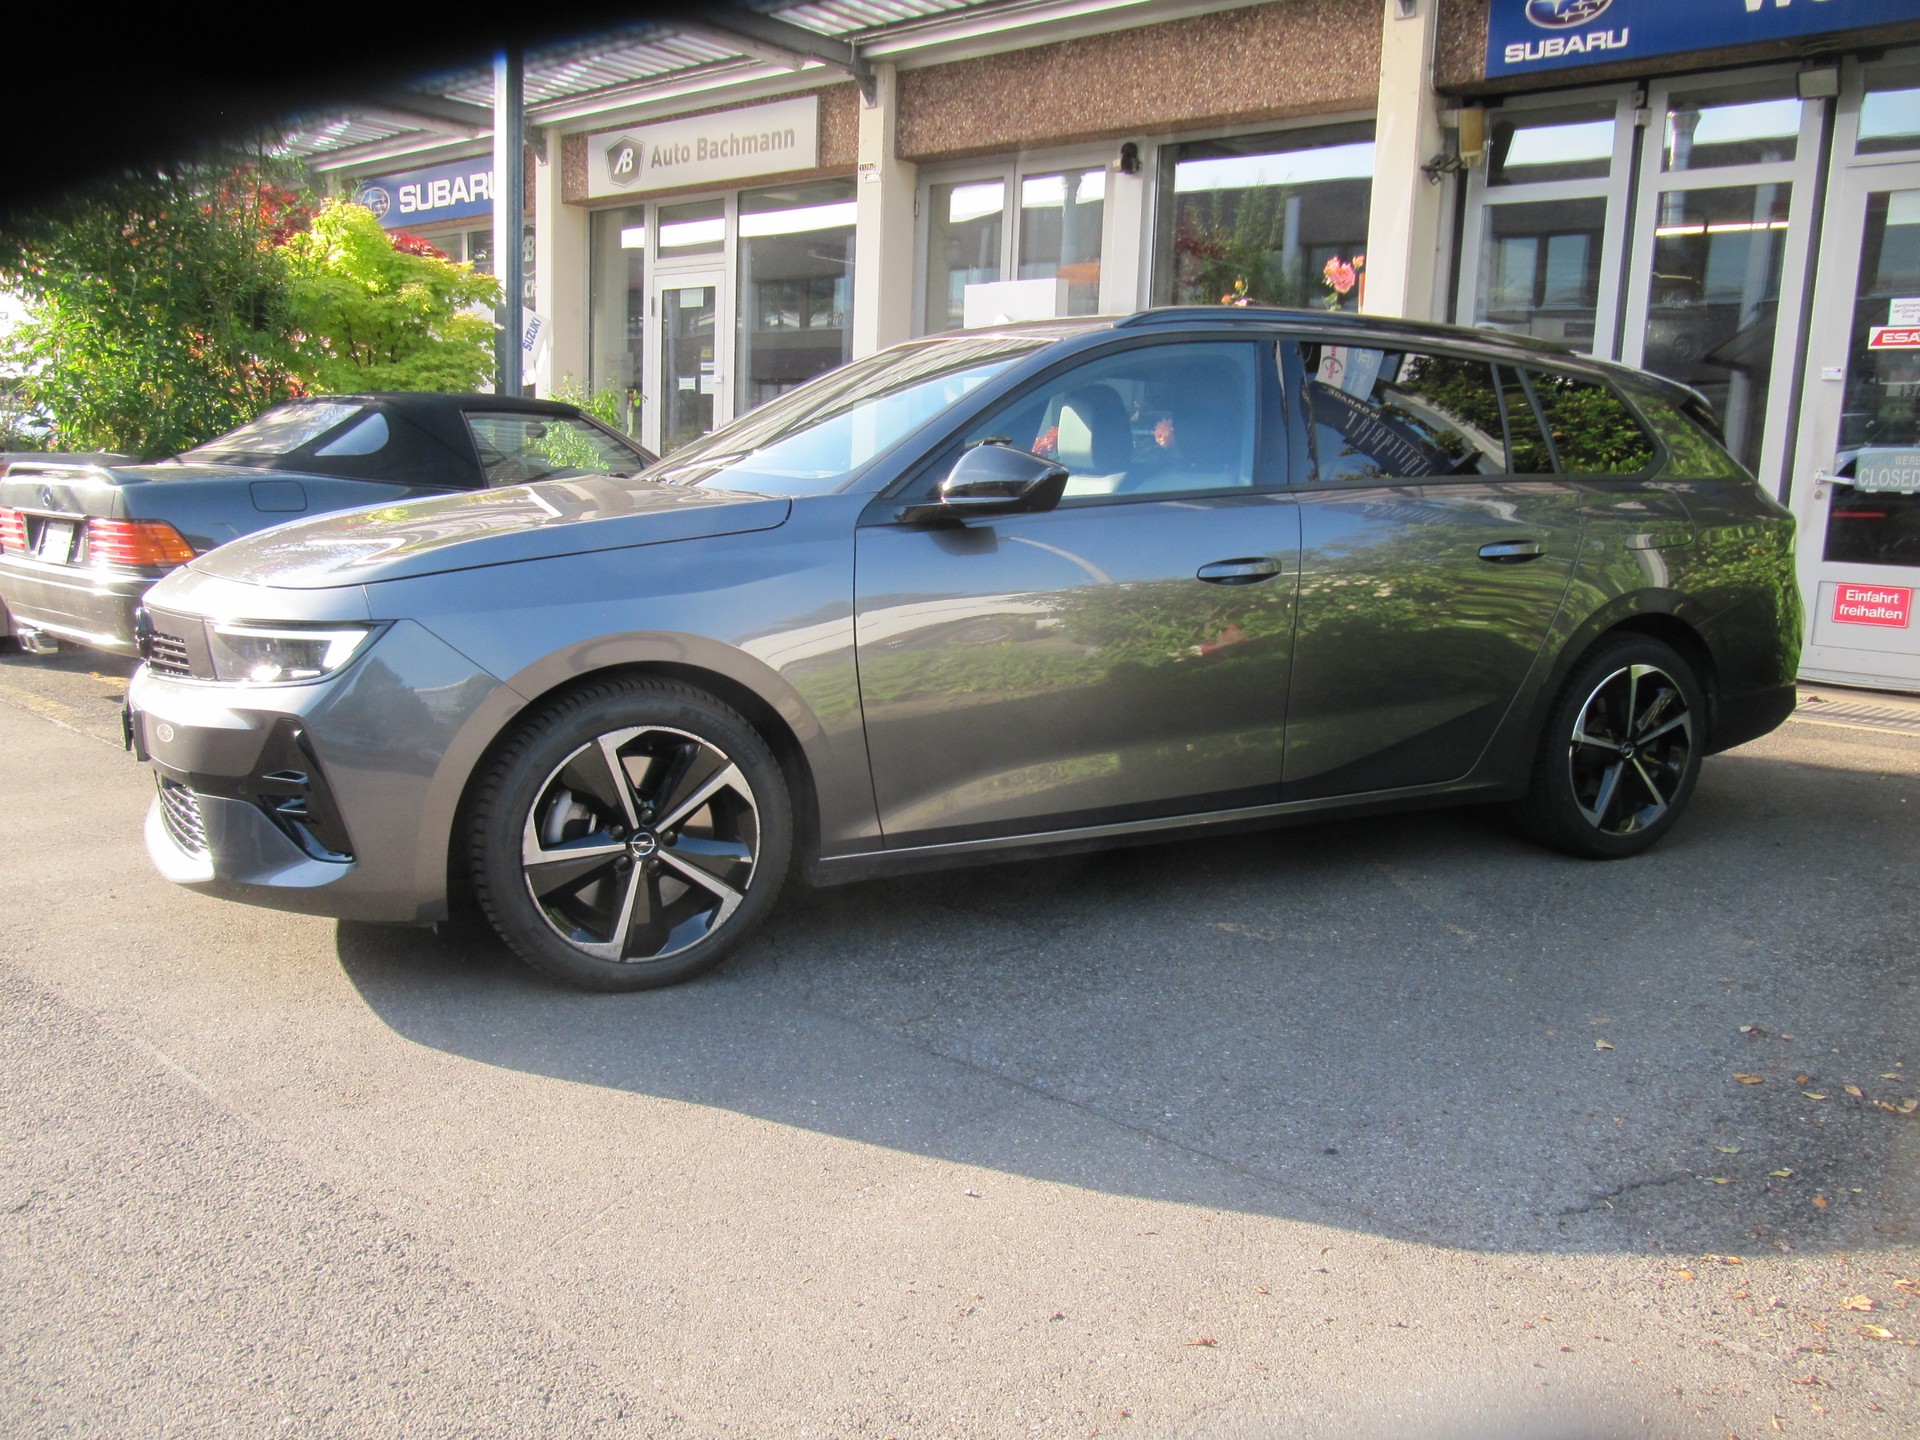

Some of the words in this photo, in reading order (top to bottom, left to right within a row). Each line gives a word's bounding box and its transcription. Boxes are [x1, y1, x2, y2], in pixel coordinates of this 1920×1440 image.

[1504, 28, 1629, 63] SUBARU
[651, 143, 691, 168] Auto
[697, 128, 795, 161] Bachmann
[522, 317, 542, 352] SUZUKI
[1839, 604, 1903, 620] freihalten
[1845, 589, 1899, 604] Einfahrt
